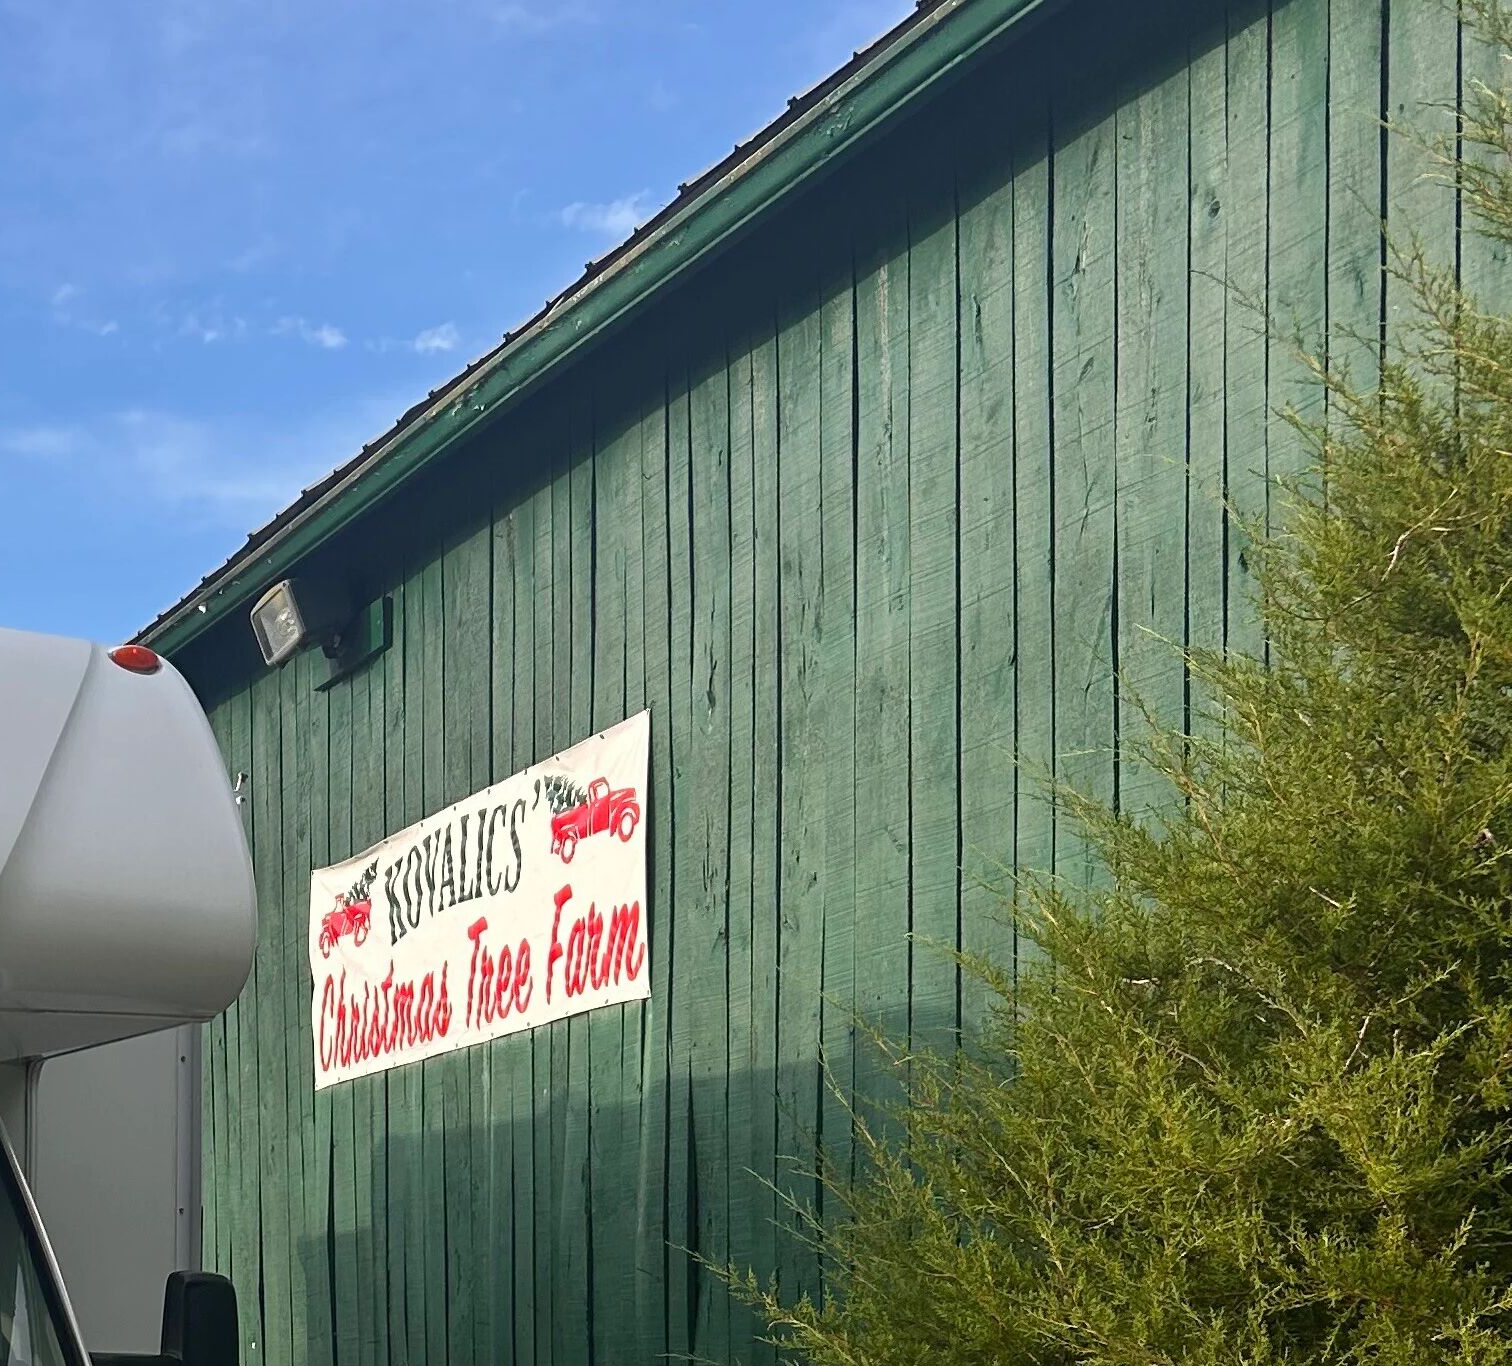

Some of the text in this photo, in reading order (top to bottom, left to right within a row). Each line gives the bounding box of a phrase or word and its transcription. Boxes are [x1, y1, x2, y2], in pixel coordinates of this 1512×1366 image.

[319, 883, 646, 1072] Christmas Tree Farm
